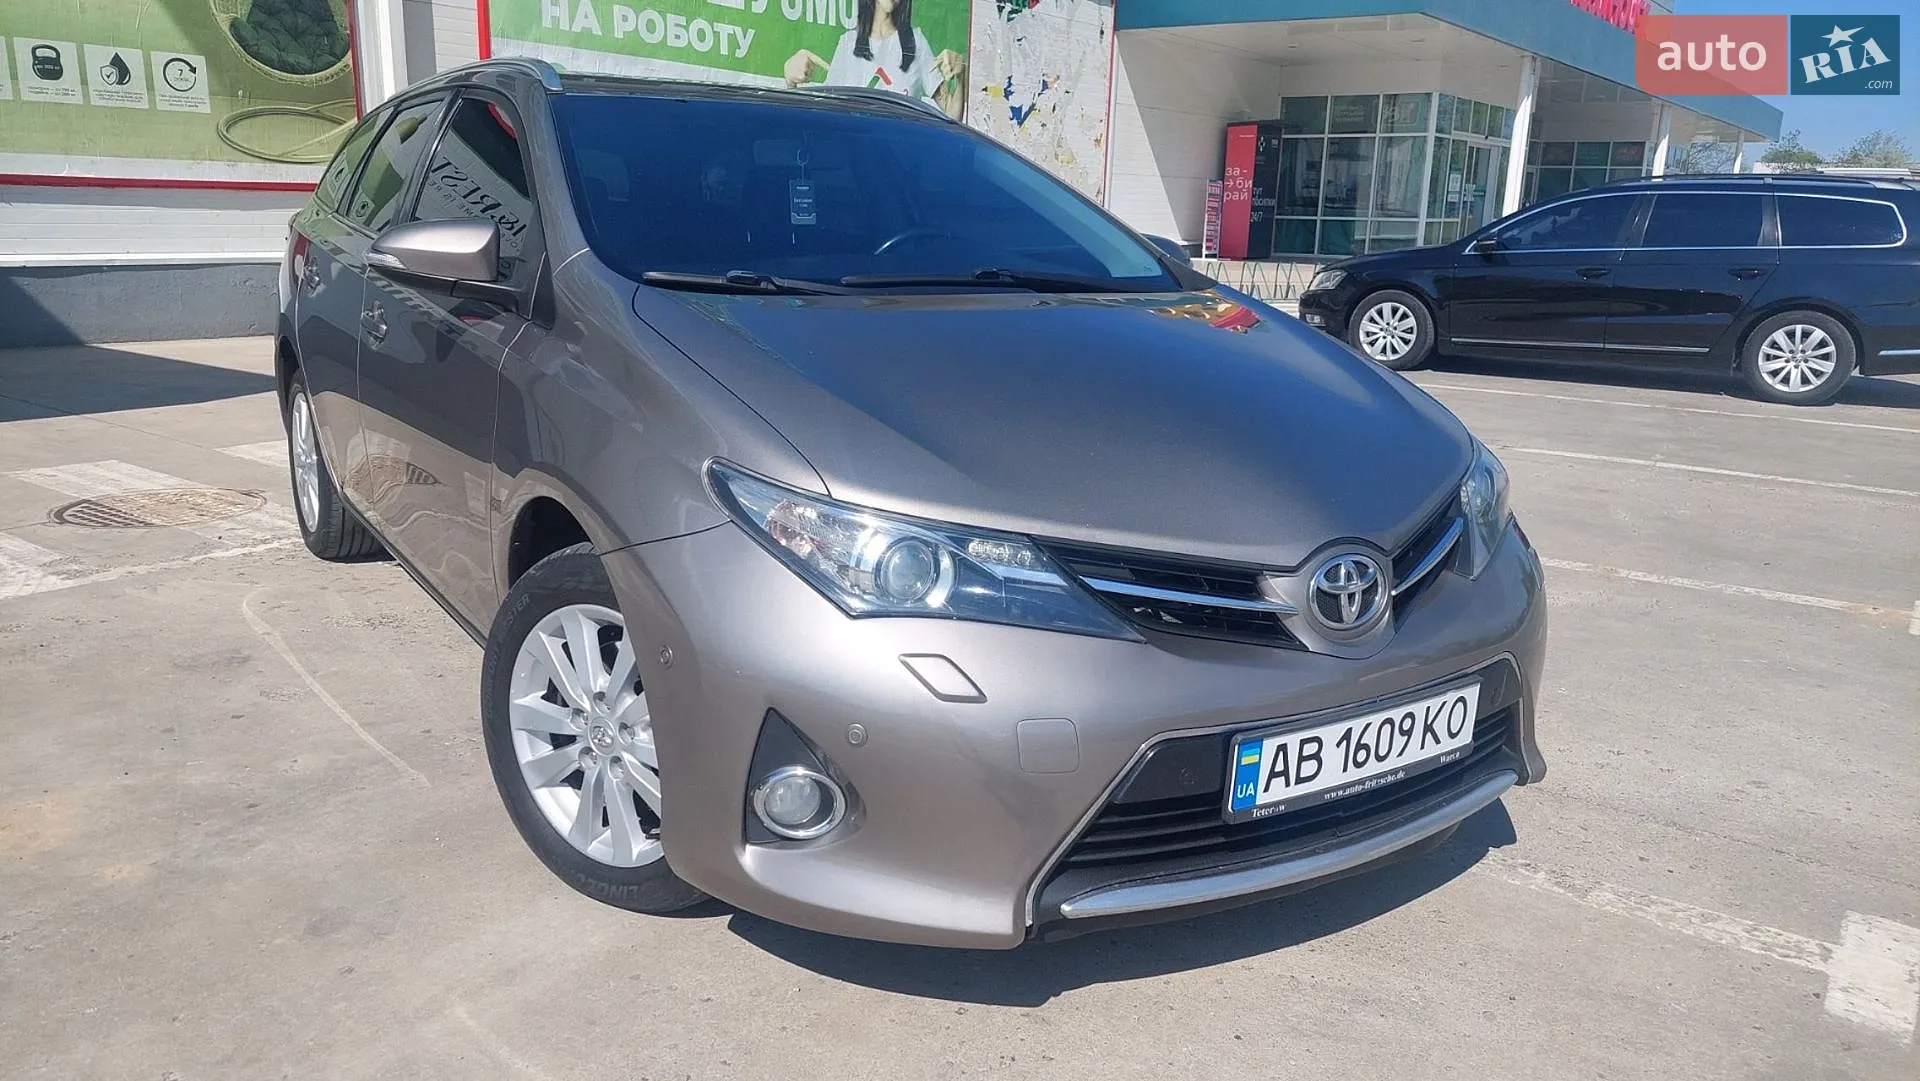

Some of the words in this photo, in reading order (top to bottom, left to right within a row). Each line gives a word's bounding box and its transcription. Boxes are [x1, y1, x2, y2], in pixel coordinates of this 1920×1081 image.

[541, 0, 602, 36] НА
[612, 4, 756, 58] РОБОТУ
[1262, 735, 1324, 793] AB
[1335, 711, 1416, 773] 1609
[1419, 695, 1468, 751] KO
[1236, 783, 1255, 799] UA
